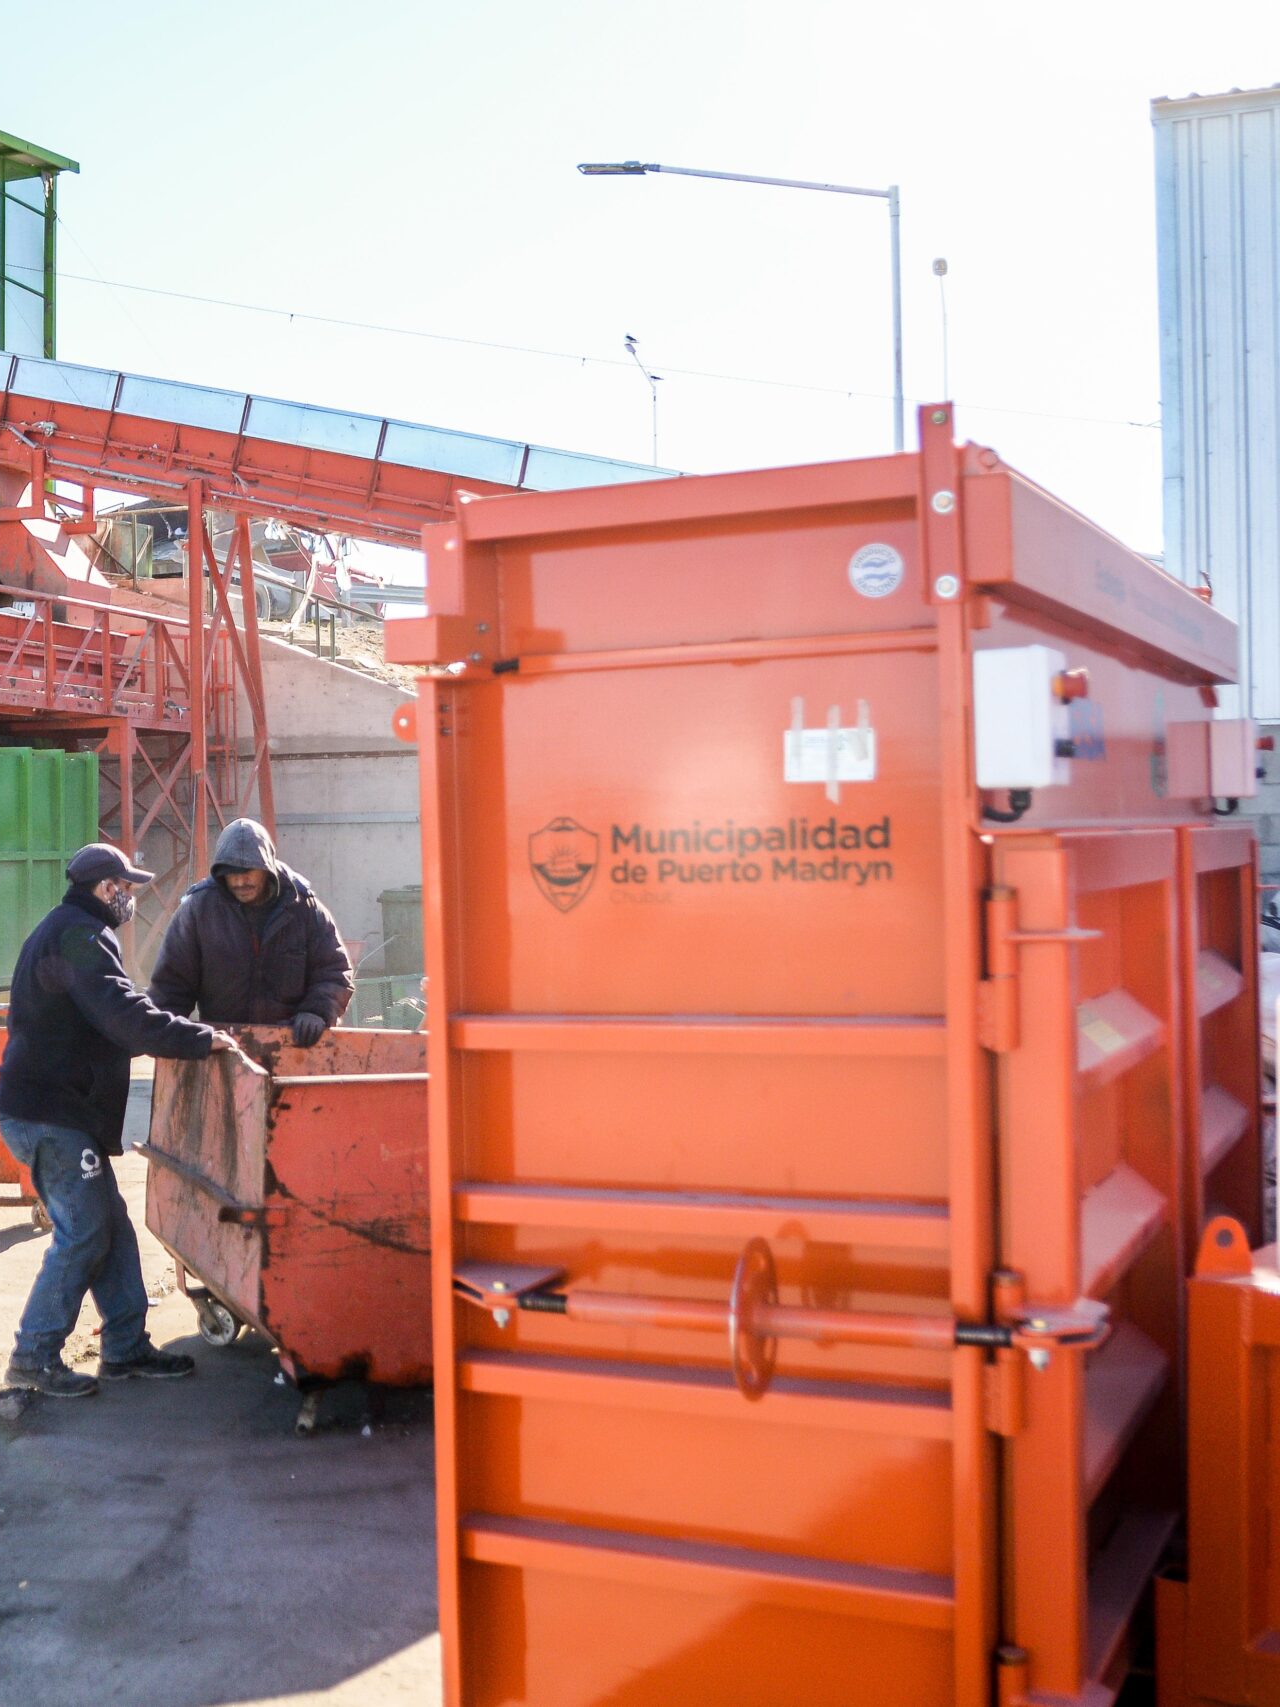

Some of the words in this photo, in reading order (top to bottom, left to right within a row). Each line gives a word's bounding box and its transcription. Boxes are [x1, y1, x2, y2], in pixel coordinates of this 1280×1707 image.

[611, 816, 891, 858] Municipalidad
[610, 859, 648, 884] de
[657, 858, 763, 884] Puerto
[772, 855, 894, 887] Madryn
[81, 1168, 102, 1180] urba
